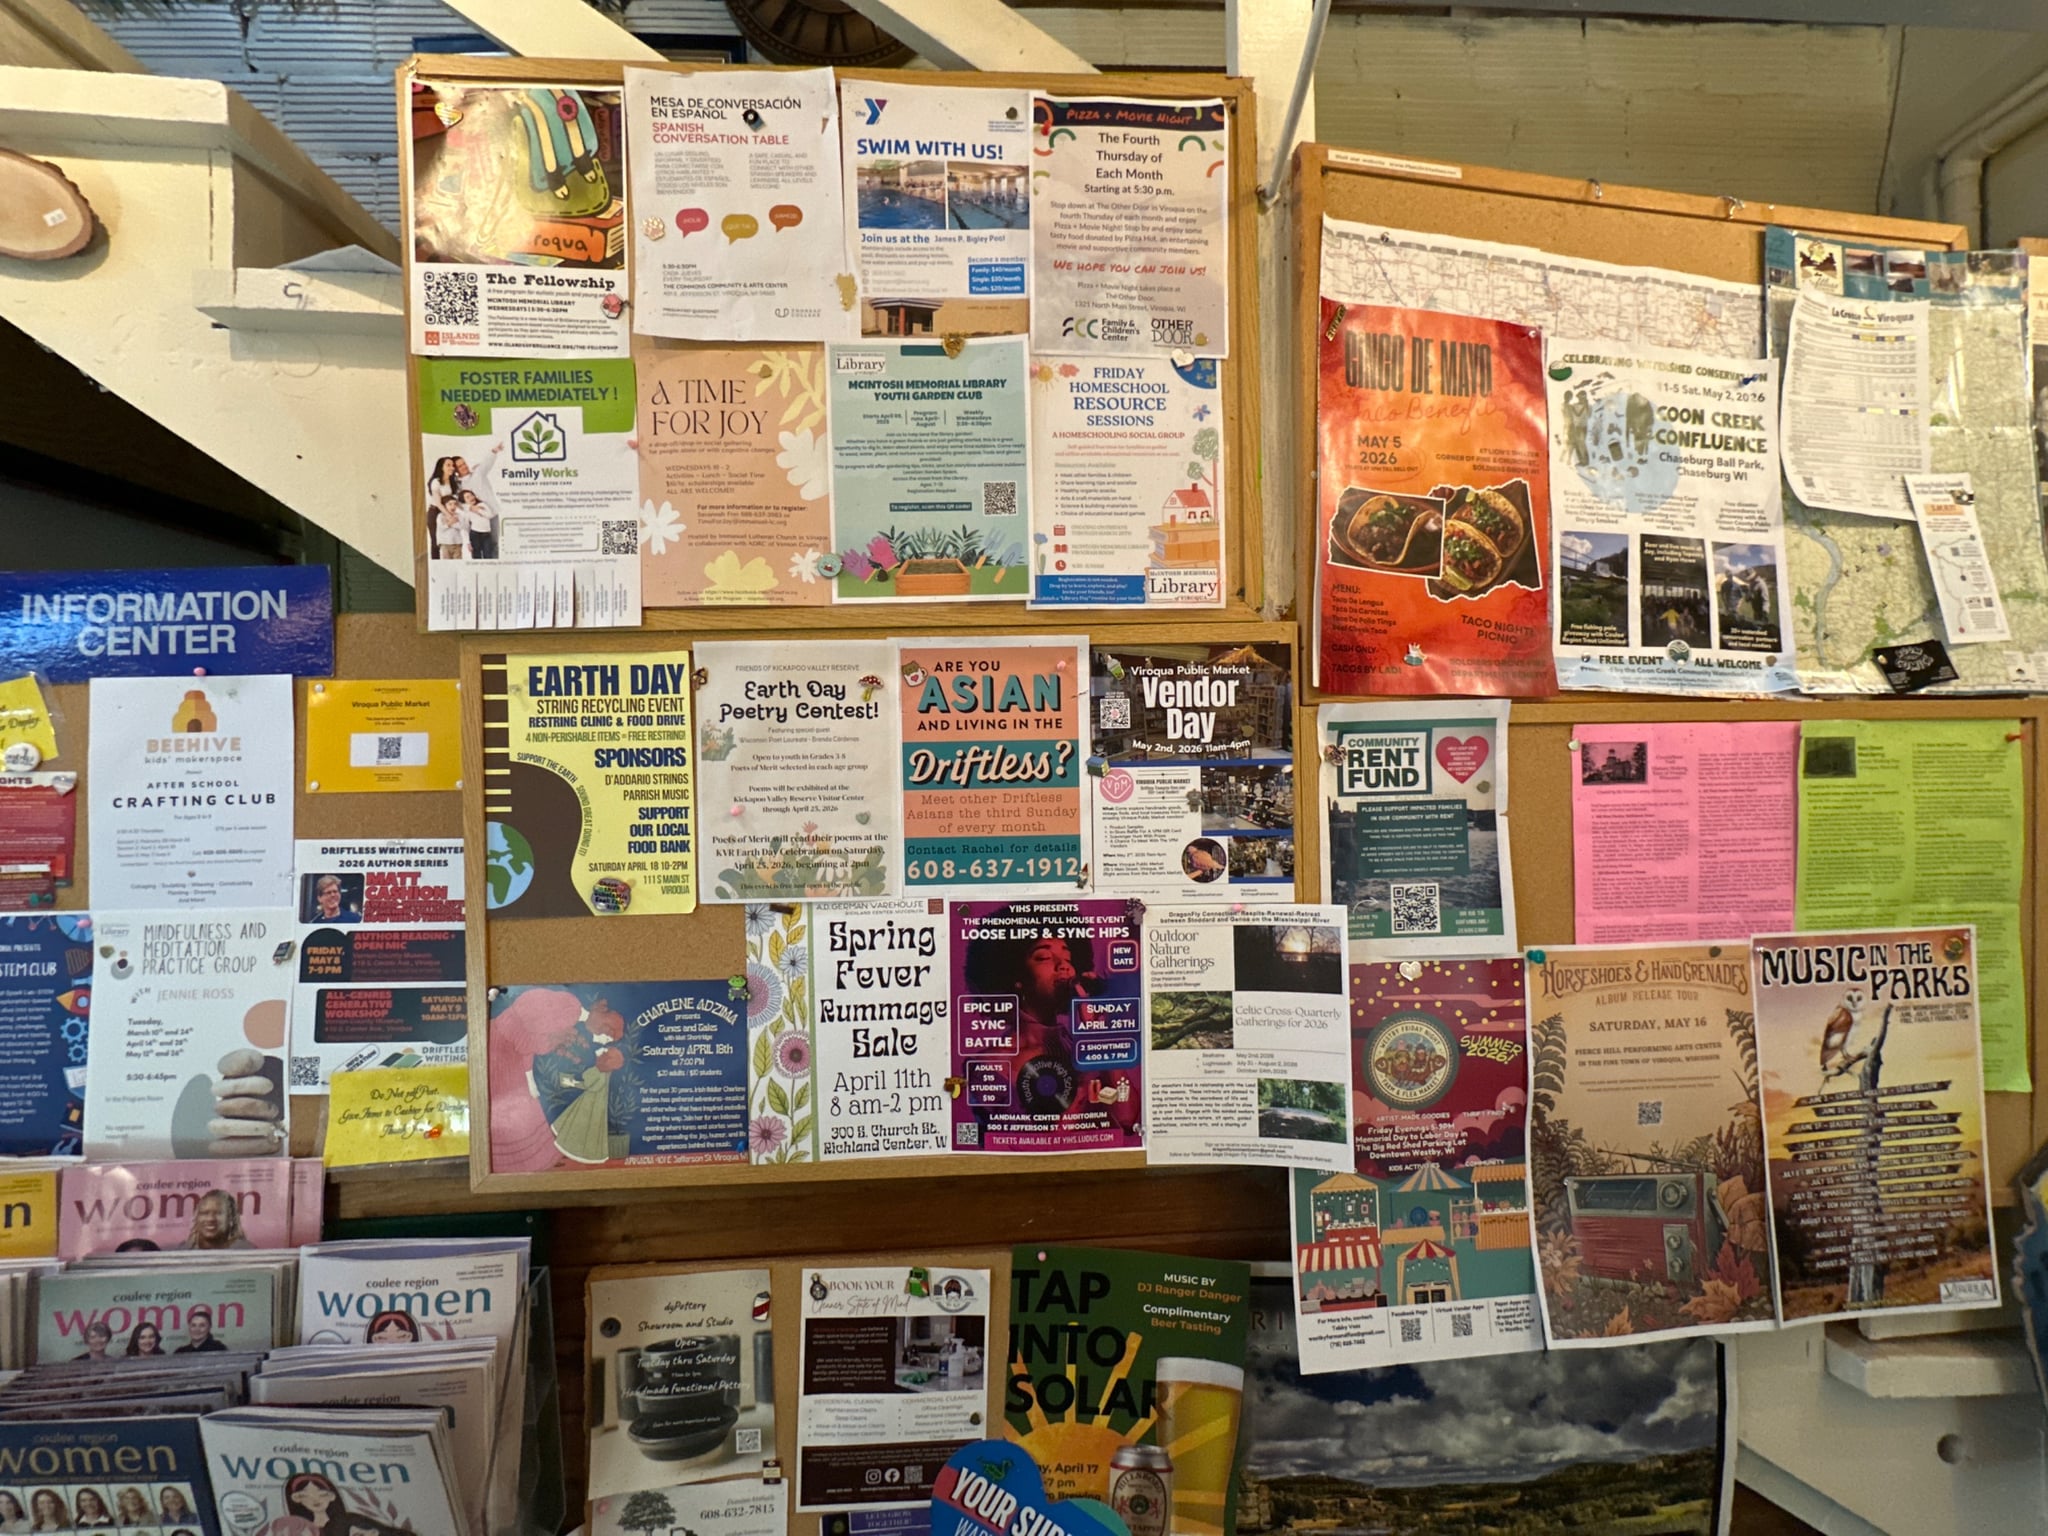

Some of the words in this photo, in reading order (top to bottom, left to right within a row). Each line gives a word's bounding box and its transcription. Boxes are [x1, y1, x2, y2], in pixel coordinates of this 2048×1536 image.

[650, 95, 684, 107] MESA
[687, 96, 703, 108] DE
[707, 96, 801, 110] CONVERSACIÓN
[651, 107, 669, 118] EN
[673, 107, 727, 120] ESPAÑOL
[652, 122, 704, 133] SPANISH
[653, 134, 749, 145] CONVERSATION
[753, 134, 789, 145] TABLE
[1098, 133, 1119, 144] The
[1123, 134, 1160, 146] Fourth
[857, 138, 910, 155] SWIM
[917, 140, 965, 157] WITH
[971, 143, 1003, 160] US!
[1096, 151, 1147, 165] Thursday
[1150, 151, 1162, 163] of
[1096, 168, 1118, 179] Each
[1122, 169, 1163, 181] Month
[1085, 184, 1119, 196] Starting
[1122, 185, 1131, 195] at
[1133, 185, 1153, 195] 5:30
[1156, 187, 1174, 197] p.m.
[486, 273, 517, 285] The
[524, 274, 616, 290] Fellowship
[1344, 331, 1405, 392] CINCO
[1412, 337, 1434, 394] DE
[1440, 341, 1493, 397] MAYO
[461, 372, 520, 385] FOSTER
[524, 371, 592, 384] FAMILIES
[1094, 367, 1144, 379] FRIDAY
[651, 380, 671, 405] A
[682, 379, 746, 405] TIME
[849, 380, 904, 390] MCINTOSH
[906, 379, 960, 389] MEMORIAL
[962, 378, 1006, 389] LIBRARY
[1070, 382, 1169, 394] HOMESCHOOL
[441, 388, 500, 403] NEEDED
[506, 388, 608, 402] IMMEDIATELY
[874, 391, 910, 402] YOUTH
[912, 391, 955, 402] GARDEN
[956, 391, 983, 401] CLUB
[1073, 397, 1166, 411] RESOURCE
[652, 411, 710, 436] FOR
[718, 410, 768, 439] JOY
[1086, 416, 1154, 426] SESSIONS
[1656, 406, 1704, 425] COON
[1711, 412, 1765, 431] CREEK
[1358, 435, 1390, 448] MAY
[1393, 437, 1401, 448] 5
[1655, 429, 1767, 453] CONFLUENCE
[1360, 452, 1397, 464] 2026
[1659, 453, 1713, 468] Chaseburg
[1717, 457, 1735, 467] Ball
[1738, 459, 1764, 470] Park,
[1149, 578, 1218, 598] Library
[21, 590, 287, 624] INFORMATION
[77, 624, 236, 657] CENTER
[934, 661, 965, 672] ARE
[969, 660, 1000, 672] YOU
[1599, 655, 1626, 665] FREE
[1629, 655, 1663, 666] EVENT
[1694, 657, 1714, 668] ALL
[1716, 658, 1762, 669] WELCOME
[1131, 666, 1174, 677] Viroqua
[1177, 665, 1208, 675] Public
[1212, 665, 1250, 676] Market
[528, 664, 623, 696] EARTH
[631, 664, 685, 695] DAY
[744, 680, 800, 699] Earth
[807, 680, 847, 701] Day
[917, 674, 1061, 714] ASIAN
[1142, 676, 1239, 708] Vendor
[352, 701, 378, 709] Viroqua
[381, 701, 403, 709] Public
[405, 700, 430, 708] Market
[537, 699, 579, 715] STRING
[582, 699, 644, 714] RECYCLING
[648, 698, 684, 713] EVENT
[720, 704, 788, 724] Poetry
[795, 701, 879, 721] Contest!
[918, 719, 951, 731] AND
[955, 719, 1007, 731] LIVING
[1012, 718, 1028, 730] IN
[1034, 717, 1063, 729] THE
[1166, 708, 1215, 743] Day
[147, 738, 240, 753] BEEHIVE
[1132, 740, 1153, 751] May
[1155, 742, 1176, 754] 2nd,
[1178, 744, 1202, 754] 2026
[1205, 738, 1251, 754] 11am-4pm
[1348, 737, 1419, 748] COMMUNITY
[594, 748, 687, 768] SPONSORS
[909, 740, 1074, 787] Driftless?
[1348, 748, 1419, 767] RENT
[147, 780, 185, 789] AFTER
[192, 779, 239, 789] SCHOOL
[1348, 767, 1419, 788] FUND
[113, 795, 217, 809] CRAFTING
[225, 793, 276, 806] CLUB
[321, 846, 377, 856] DRIFTLESS
[380, 846, 424, 855] WRITING
[339, 859, 364, 869] 2026
[367, 858, 411, 868] AUTHOR
[413, 858, 448, 868] SERIES
[907, 856, 1079, 880] 608-637-1912
[144, 923, 233, 940] MINDFULNESS
[241, 923, 267, 939] AND
[828, 921, 936, 956] Spring
[962, 927, 1006, 940] LOOSE
[1010, 926, 1038, 940] LIPS
[1043, 926, 1053, 939] &
[1057, 926, 1095, 938] SYNC
[1100, 925, 1129, 938] HIPS
[1149, 929, 1200, 942] Outdoor
[144, 939, 226, 957] MEDITATION
[1149, 942, 1190, 955] Nature
[1870, 945, 1888, 966] IN
[1895, 943, 1933, 964] THE
[142, 957, 207, 975] PRACTICE
[213, 956, 257, 974] GROUP
[1149, 955, 1215, 969] Gatherings
[1761, 946, 1867, 986] MUSIC
[836, 960, 931, 990] Fever
[1635, 960, 1649, 982] &
[1870, 965, 1971, 1000] PARKS
[637, 997, 696, 1028] CHARLENE
[696, 999, 737, 1027] ADZIMA
[820, 999, 948, 1025] Rummage
[1589, 1019, 1661, 1032] SATURDAY,
[1664, 1018, 1690, 1029] MAY
[1692, 1016, 1707, 1027] 16
[852, 1029, 918, 1059] Sale
[127, 1071, 177, 1083] 5:30-6:45pm
[834, 1071, 886, 1094] April
[895, 1068, 932, 1089] 11th
[830, 1097, 840, 1115] 8
[848, 1094, 901, 1116] am-2
[909, 1097, 943, 1114] pm
[366, 1278, 401, 1287] coulee
[403, 1278, 439, 1288] region
[1164, 1273, 1198, 1285] MUSIC
[1201, 1277, 1216, 1287] BY
[1013, 1269, 1111, 1314] TAP
[317, 1284, 493, 1320] women
[665, 1301, 706, 1313] dyPottery
[638, 1319, 683, 1332] Showroom
[686, 1319, 702, 1329] and
[706, 1317, 733, 1328] Studio
[1009, 1324, 1127, 1368] INTO
[0, 1440, 178, 1475] women
[220, 1453, 411, 1487] women
[950, 1465, 1018, 1529] YOUR
[700, 1504, 775, 1519] 608-632-7815
